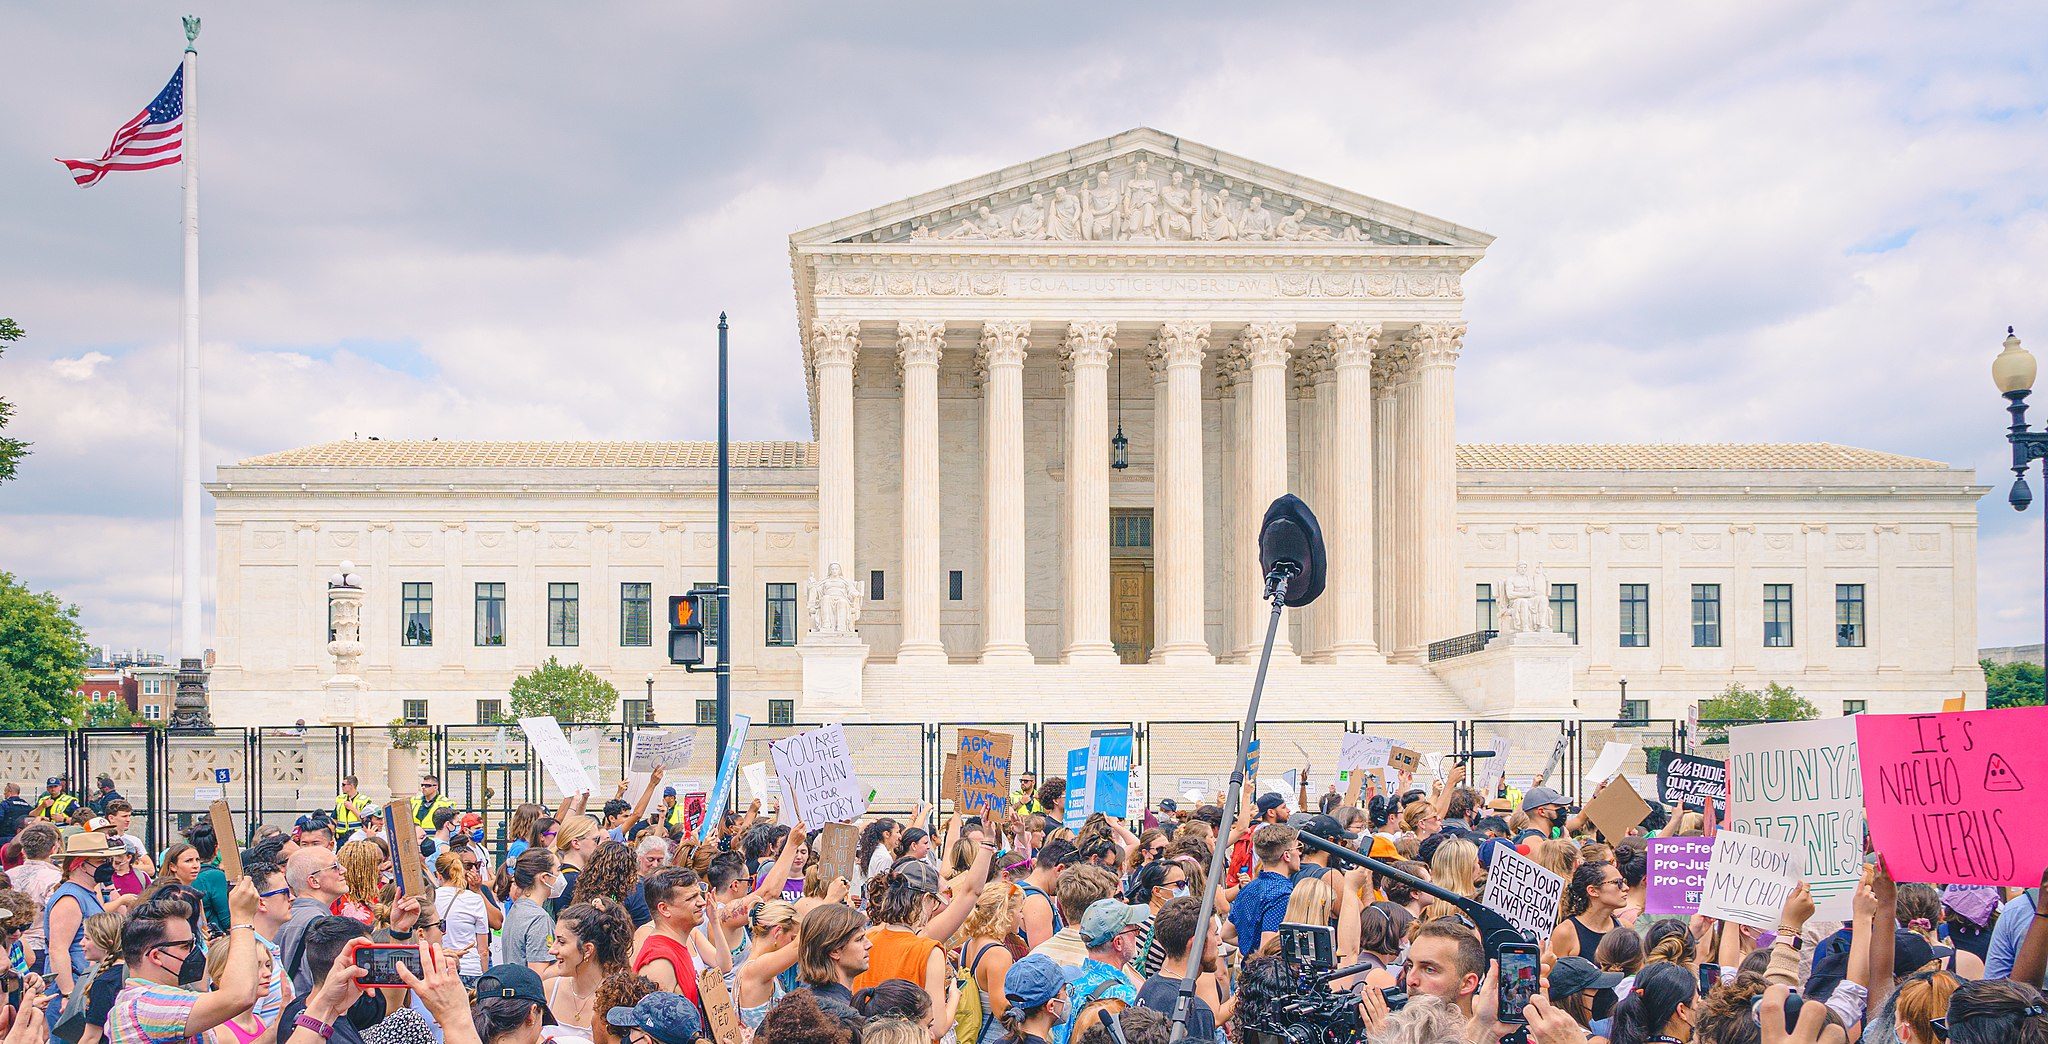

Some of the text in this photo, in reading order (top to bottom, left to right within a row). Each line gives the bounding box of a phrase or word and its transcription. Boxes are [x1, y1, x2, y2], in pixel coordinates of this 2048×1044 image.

[1019, 278, 1262, 292] EQUAL JUSTICE UNDER LAW
[815, 730, 840, 749] ARE
[1908, 715, 1974, 755] It's
[774, 736, 814, 767] YOU
[815, 745, 841, 761] THE
[1098, 755, 1128, 772] WELCOME
[783, 760, 847, 793] VILLAIN
[1666, 776, 1692, 790] OUR
[1667, 758, 1726, 783] Our BODIE
[1734, 741, 1862, 803] NUNYA
[1879, 756, 1961, 806] NACHO
[806, 787, 840, 805] IN OUR
[1654, 842, 1711, 855] Pro-Fre
[1719, 840, 1790, 877] MY BODY
[1911, 808, 2015, 882] UTERUS
[1498, 850, 1560, 900] KEEP YOUR
[1654, 859, 1710, 871] Pro-Jus
[1491, 865, 1556, 917] RELIGION
[1653, 875, 1706, 887] Pro-Ch
[1710, 872, 1795, 909] MY CHOI
[1489, 886, 1526, 920] AWAY
[1525, 905, 1552, 934] FROM
